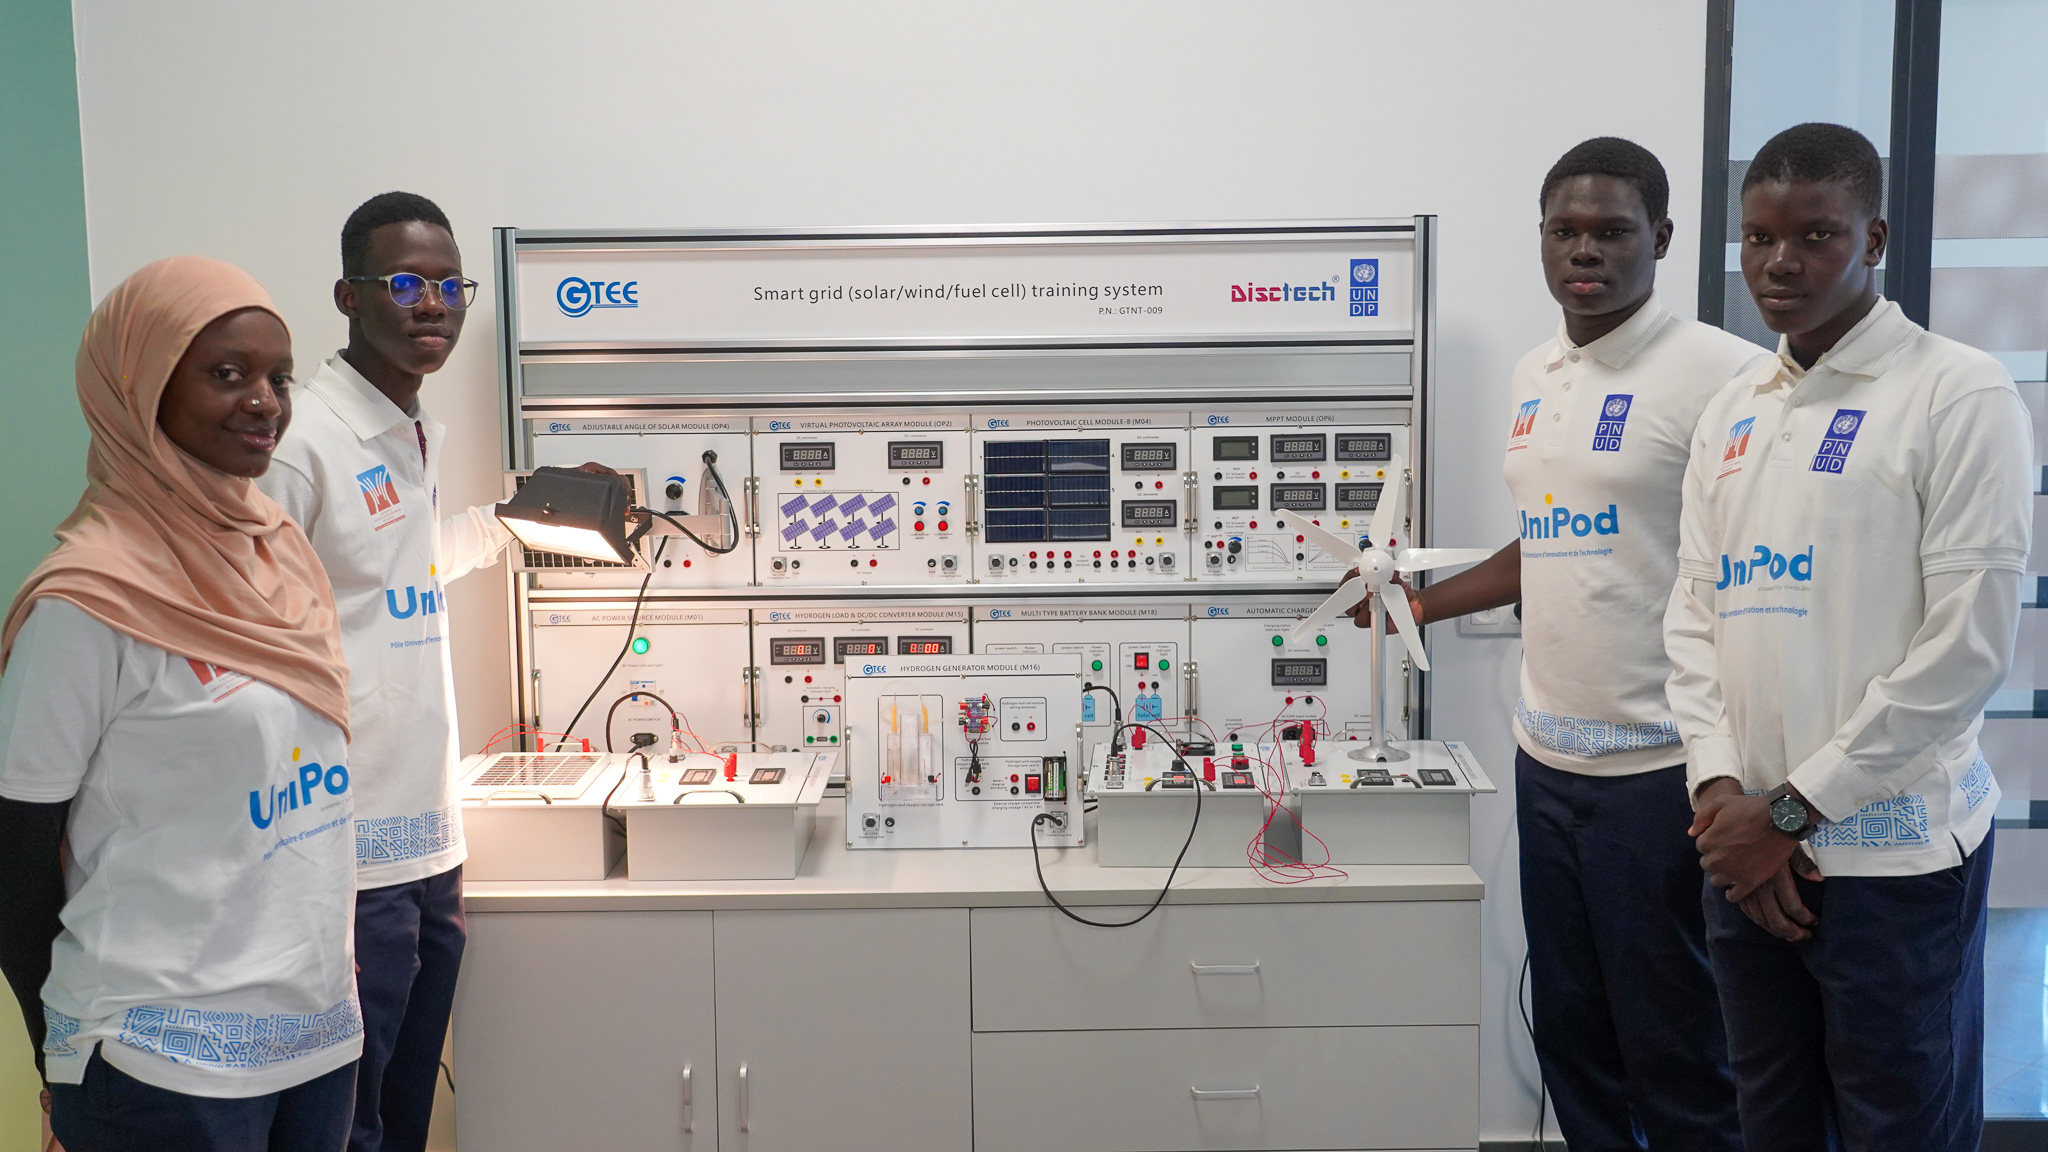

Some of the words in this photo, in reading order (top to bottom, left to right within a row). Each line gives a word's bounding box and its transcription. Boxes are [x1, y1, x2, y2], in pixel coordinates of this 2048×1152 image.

[557, 276, 638, 318] GTEE
[753, 286, 804, 301] Smart
[809, 285, 843, 304] grid
[848, 283, 986, 302] (solar/wind/fuel
[991, 283, 1026, 300] cell)
[1031, 282, 1099, 301] training
[1103, 283, 1163, 299] system
[1352, 289, 1376, 301] UN
[1119, 306, 1163, 315] GTNT-009
[1352, 304, 1376, 316] DP
[904, 420, 933, 428] MODULE
[934, 420, 952, 428] (OP2)
[1094, 418, 1131, 426] MODULE-B
[1132, 418, 1152, 426] (M04)
[1517, 493, 1620, 540] UniPod
[1579, 547, 1613, 556] Technologie
[591, 614, 601, 622] AC
[602, 614, 626, 622] POWER
[655, 614, 684, 622] MODULE
[684, 614, 704, 622] (M01)
